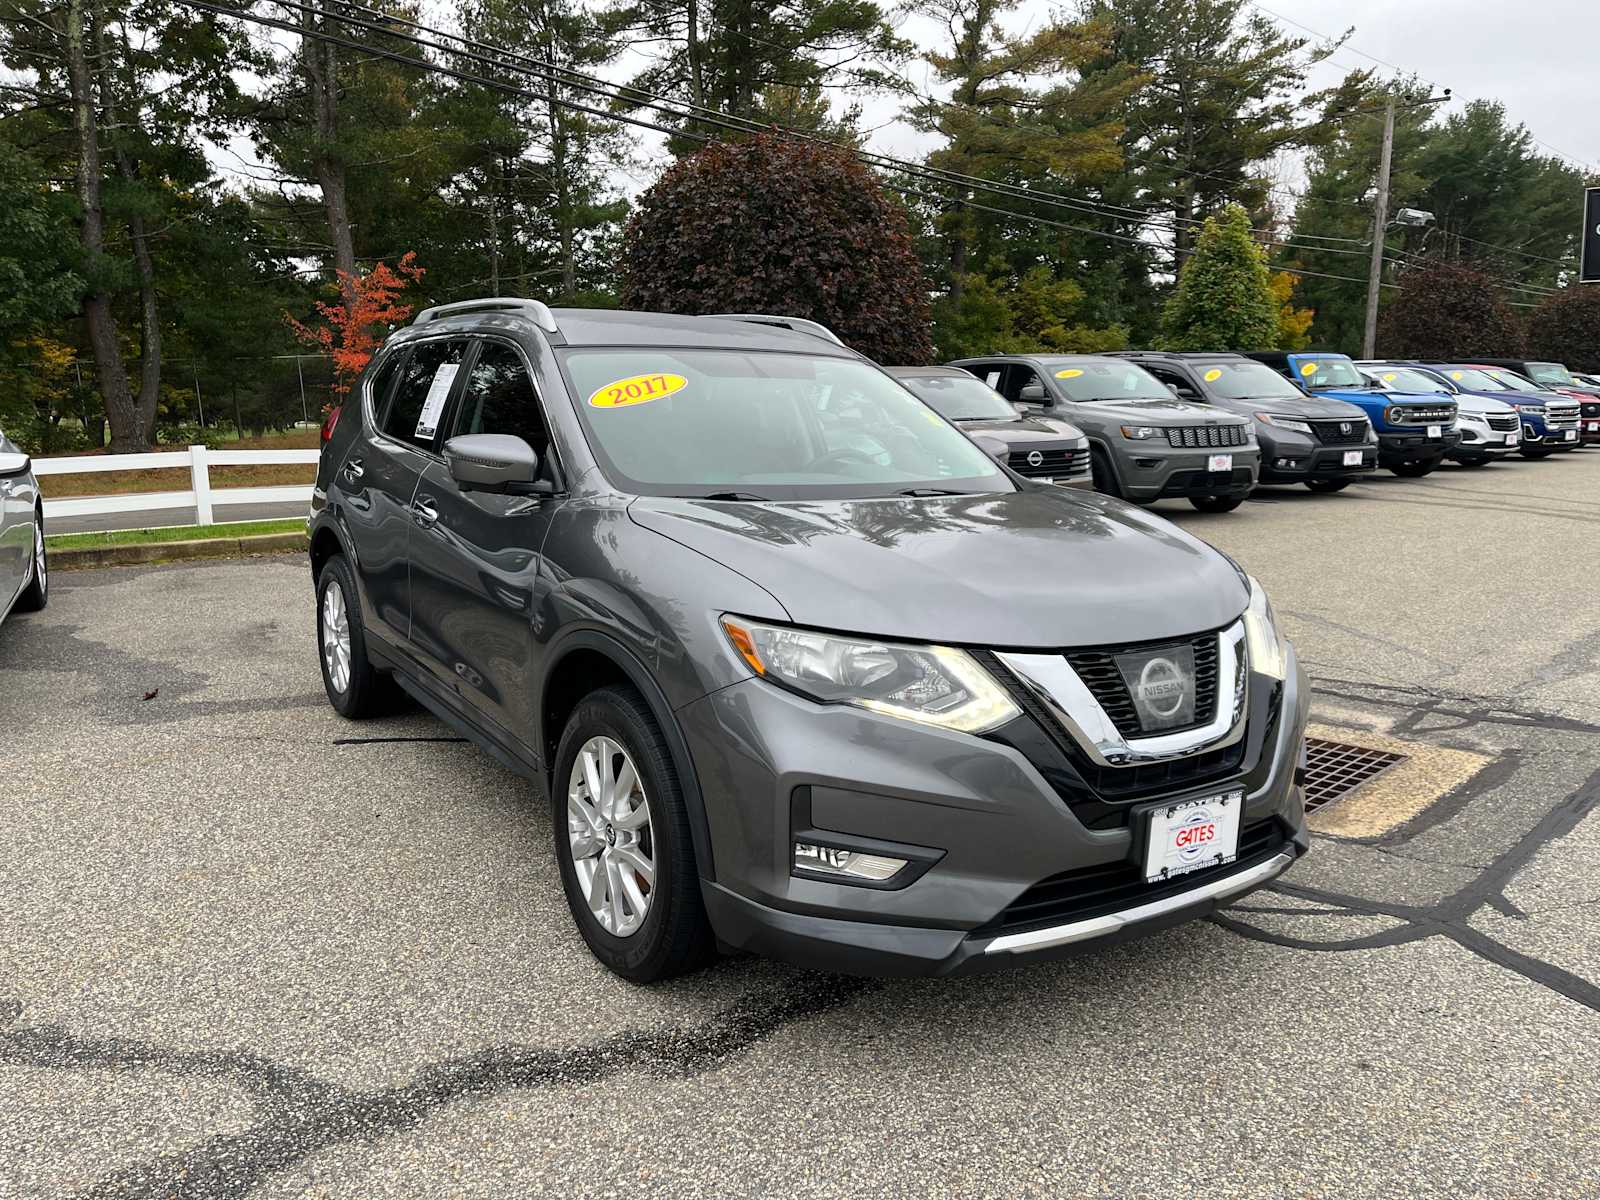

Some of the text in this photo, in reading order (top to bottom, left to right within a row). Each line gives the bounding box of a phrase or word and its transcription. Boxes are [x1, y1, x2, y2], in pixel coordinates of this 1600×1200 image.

[608, 376, 668, 405] 2017
[1144, 681, 1185, 697] NISSAN
[1175, 824, 1215, 847] GATES
